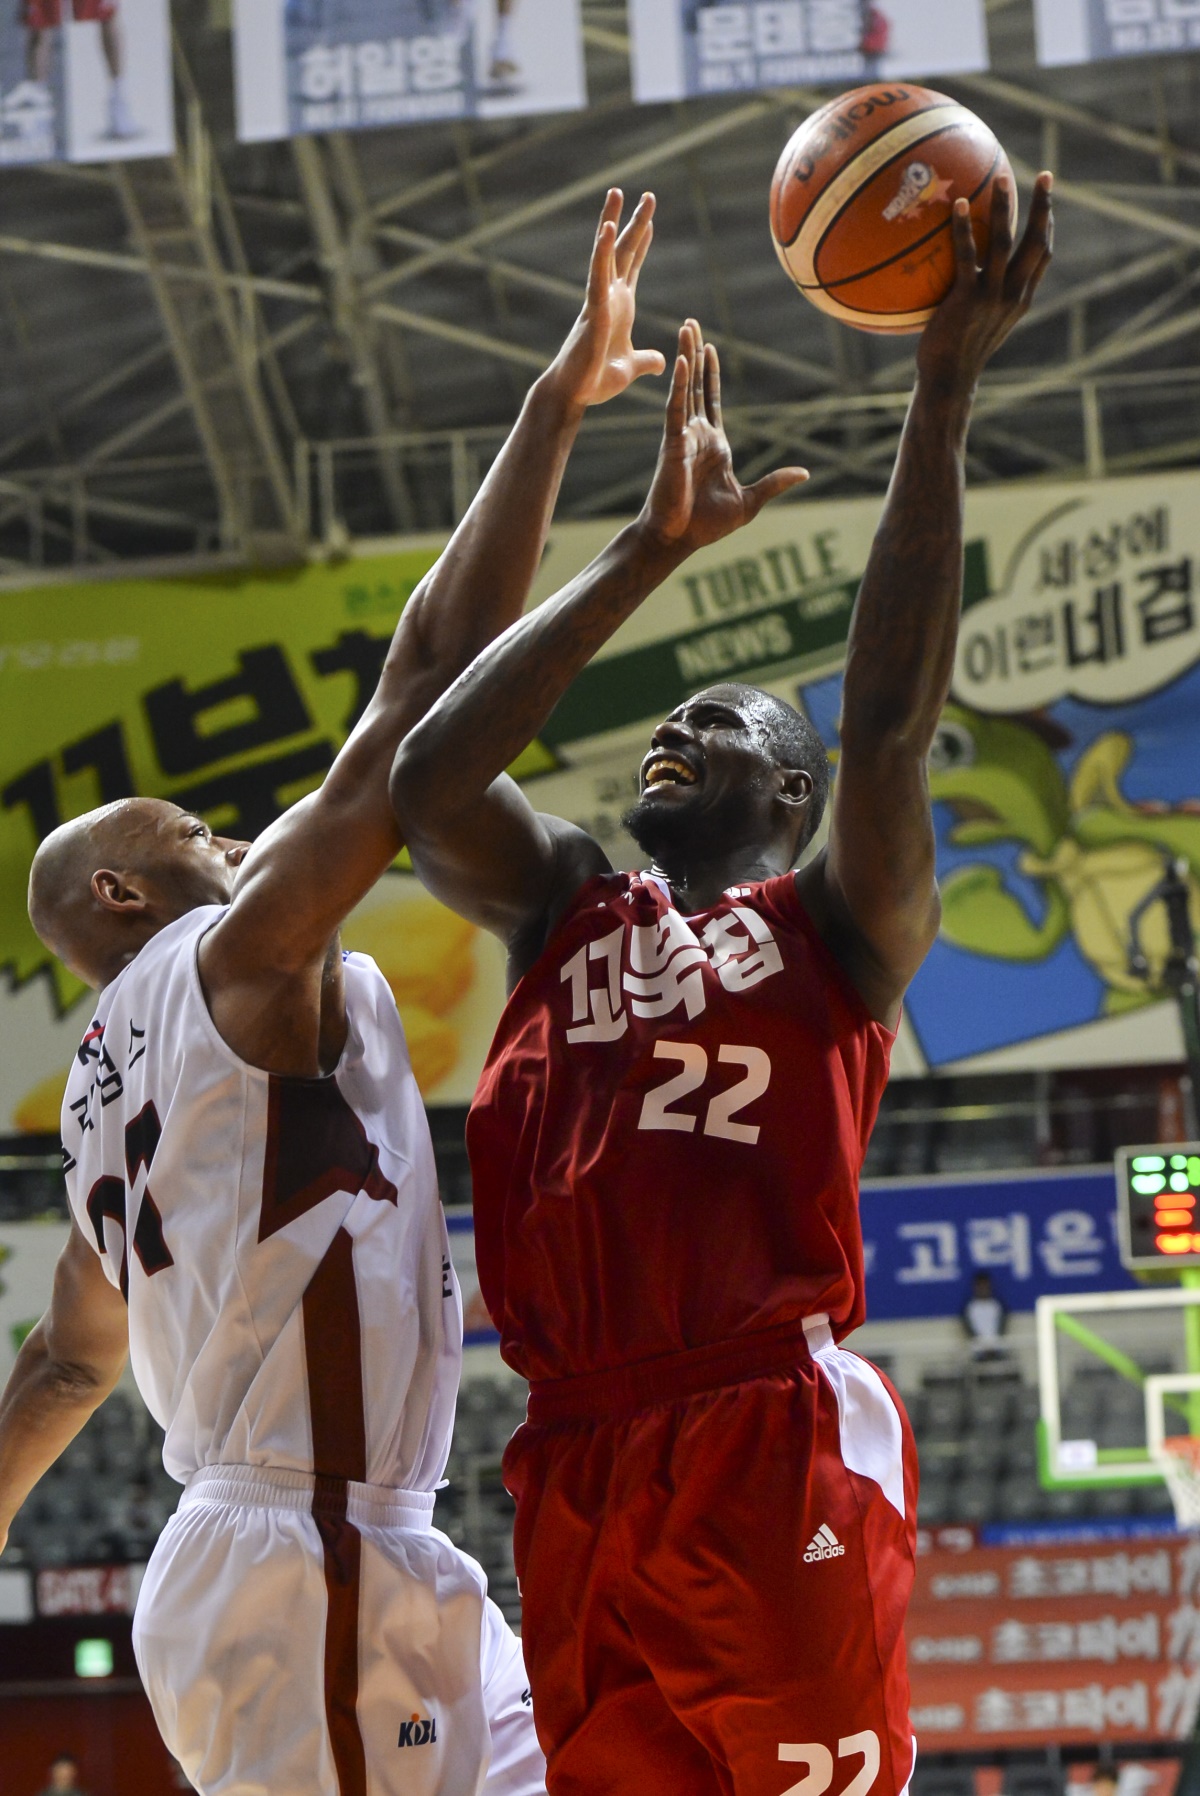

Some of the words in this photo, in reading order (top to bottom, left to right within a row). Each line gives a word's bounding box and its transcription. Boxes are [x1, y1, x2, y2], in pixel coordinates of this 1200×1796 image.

[301, 35, 464, 99] 허일영
[680, 528, 848, 618] TURTLE
[1038, 502, 1168, 588] 세상에
[675, 613, 793, 683] NEWS
[963, 608, 1056, 686] 이런
[637, 1039, 772, 1145] 22
[896, 1210, 1118, 1285] 고려은
[803, 1544, 845, 1563] adidas
[1010, 1551, 1169, 1598] 초코파이
[993, 1613, 1159, 1664] 초코파이
[398, 1718, 437, 1748] KBL
[974, 1681, 1149, 1732] 초코파이
